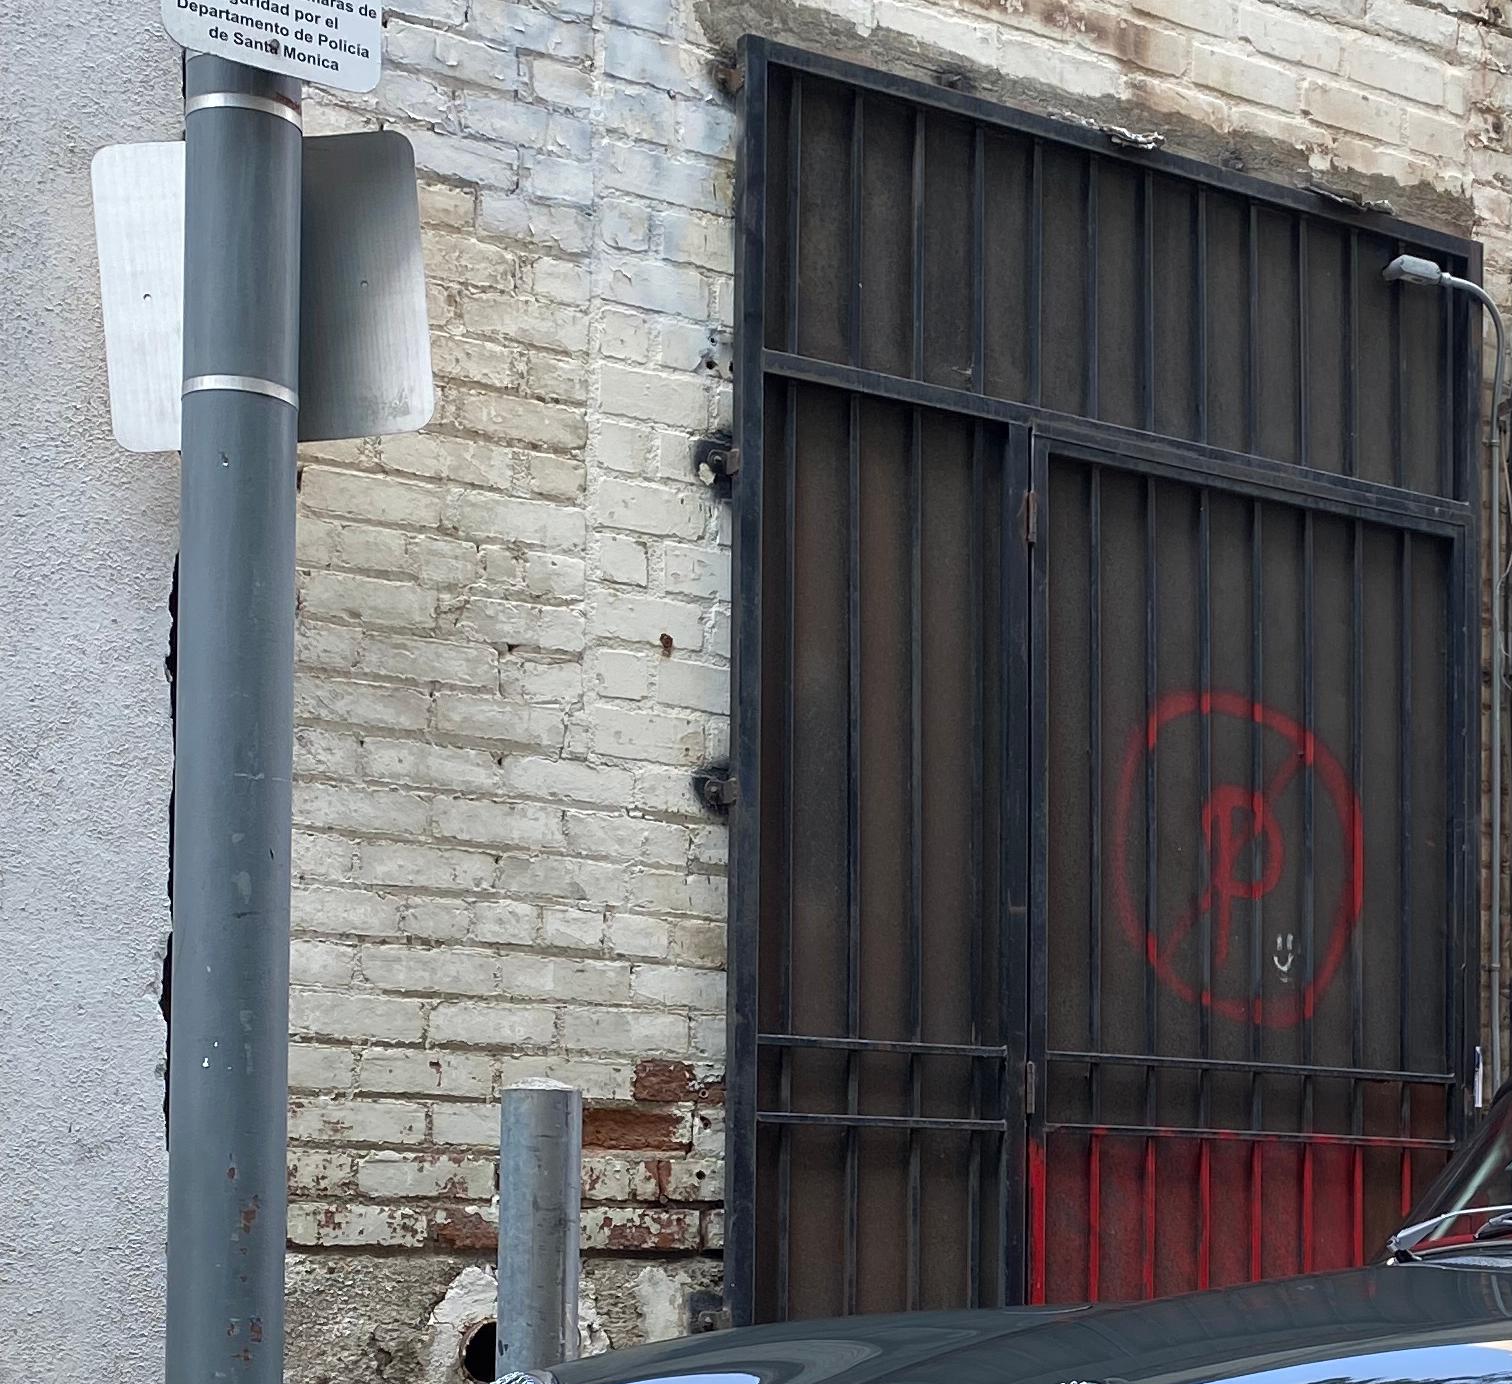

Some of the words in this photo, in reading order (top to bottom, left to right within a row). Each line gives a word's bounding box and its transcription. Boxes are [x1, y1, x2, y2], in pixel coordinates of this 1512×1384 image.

[177, 0, 289, 36] Departamento
[294, 28, 313, 43] de
[295, 9, 321, 24] por
[325, 17, 338, 29] el
[358, 4, 377, 19] de
[209, 26, 228, 41] de
[233, 31, 279, 55] Santa
[283, 45, 339, 71] Monica
